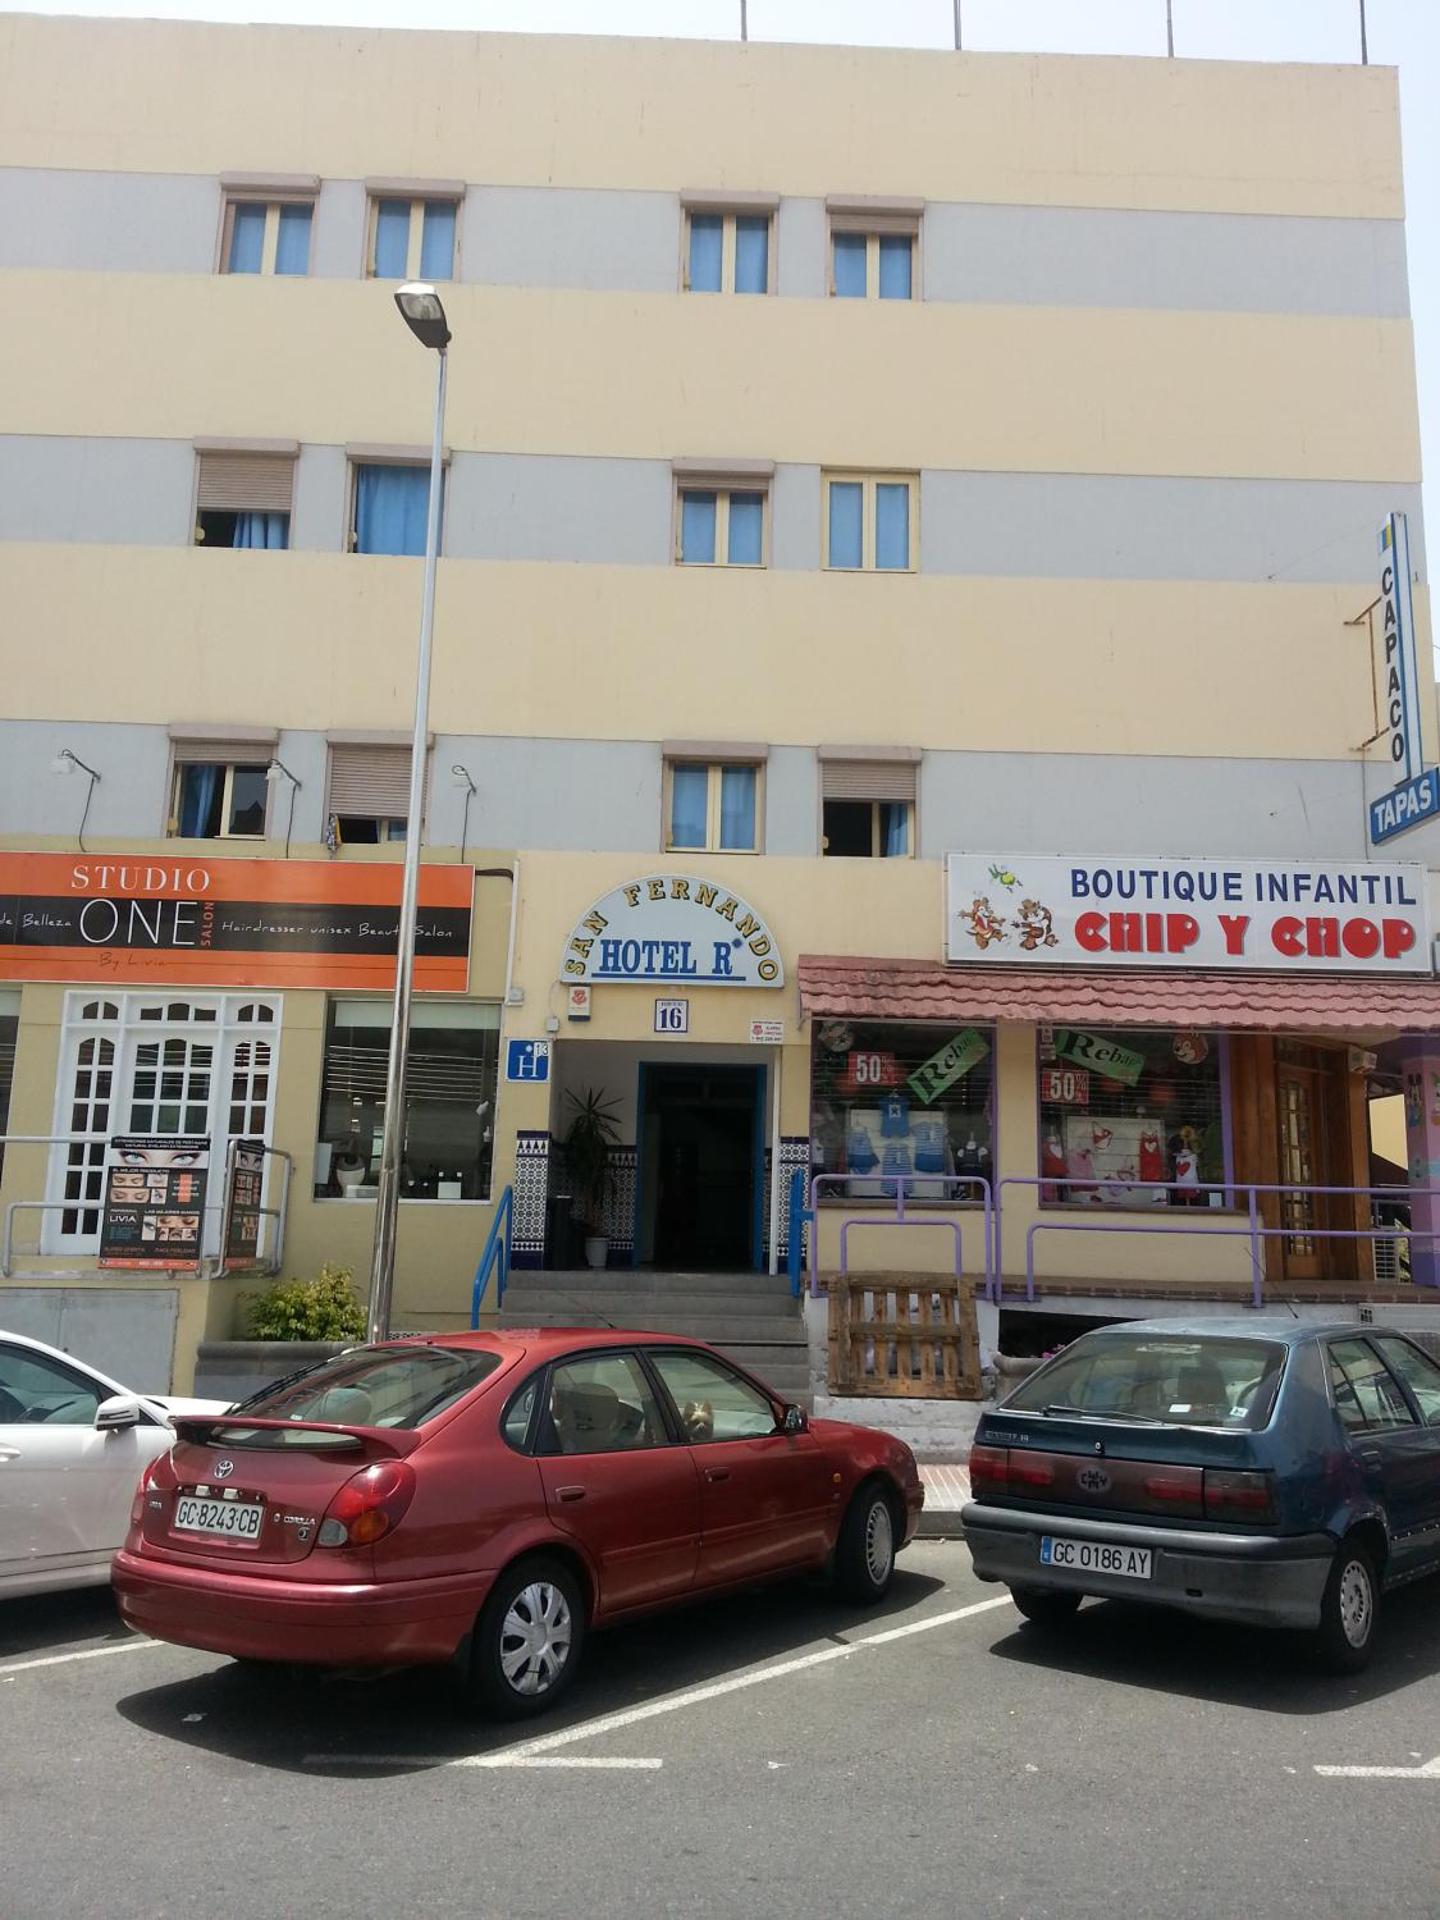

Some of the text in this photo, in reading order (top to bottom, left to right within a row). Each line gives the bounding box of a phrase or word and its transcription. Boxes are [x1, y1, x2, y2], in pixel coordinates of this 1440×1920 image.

[1381, 566, 1405, 762] CAPACO
[1374, 778, 1433, 834] TAPAS
[71, 865, 210, 893] STUDIO
[1070, 868, 1417, 905] BOUTIQUE INFANTIL
[22, 913, 72, 928] Belleza
[79, 898, 198, 945] ONE
[201, 901, 215, 947] SALON
[222, 919, 452, 937] Hairdresser unisex Beaut Salon
[564, 878, 779, 981] SAN FERNANDO
[1074, 911, 1415, 959] CHIP Y CHOP
[100, 952, 119, 970] By
[599, 938, 733, 975] HOTEL R
[659, 1007, 682, 1029] 16
[516, 1055, 539, 1077] H
[109, 1215, 137, 1223] LIVIA
[1054, 1542, 1148, 1574] GC 0186 AY
